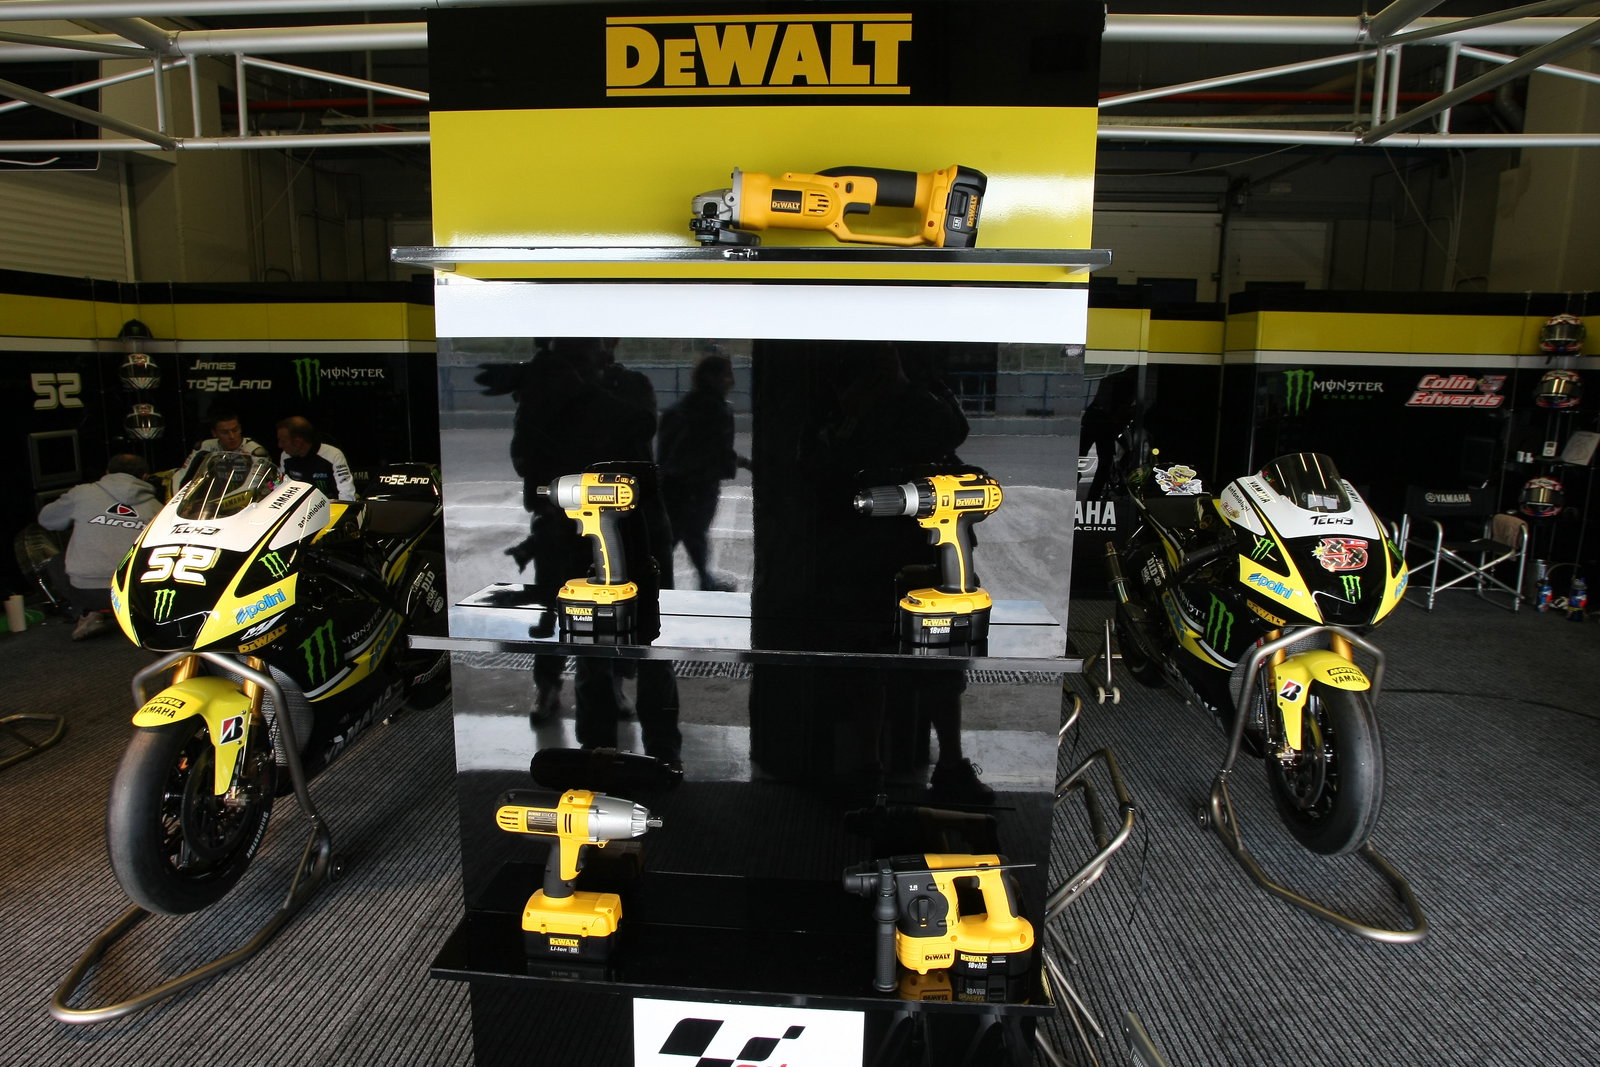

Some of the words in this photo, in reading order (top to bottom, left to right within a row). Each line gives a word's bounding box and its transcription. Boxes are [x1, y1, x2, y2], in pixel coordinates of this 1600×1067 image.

[320, 367, 385, 379] MONSTER
[31, 373, 84, 410] 52
[1313, 379, 1384, 393] MONSTER
[1418, 375, 1477, 392] Colin
[1405, 391, 1504, 408] Edwards
[268, 486, 301, 510] YAMAHA
[1435, 493, 1472, 504] YAMAHA
[141, 545, 222, 586] 52
[1256, 576, 1294, 600] polini
[250, 588, 287, 619] polini
[925, 953, 950, 961] DEWALT
